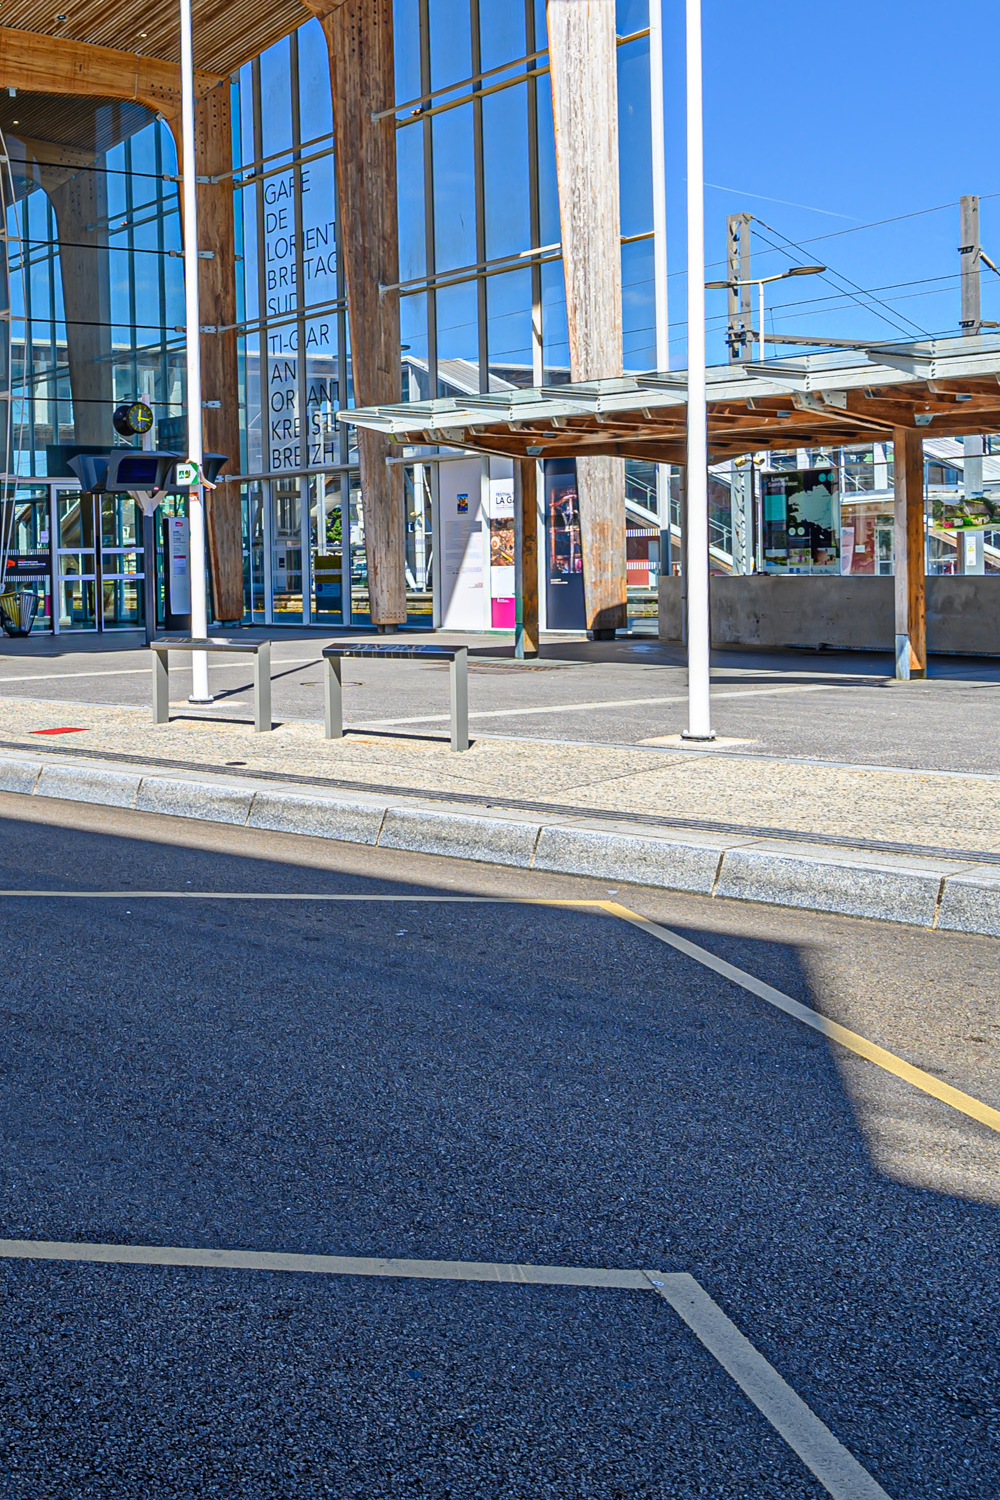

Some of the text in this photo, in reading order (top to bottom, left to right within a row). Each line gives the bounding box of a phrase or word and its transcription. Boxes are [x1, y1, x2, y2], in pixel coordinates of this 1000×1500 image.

[266, 208, 288, 234] DE
[267, 251, 337, 291] BRETAG
[269, 323, 330, 355] TI-GAR
[271, 359, 296, 385] AN
[271, 381, 340, 413] ORANT
[272, 442, 335, 469] BREIZH
